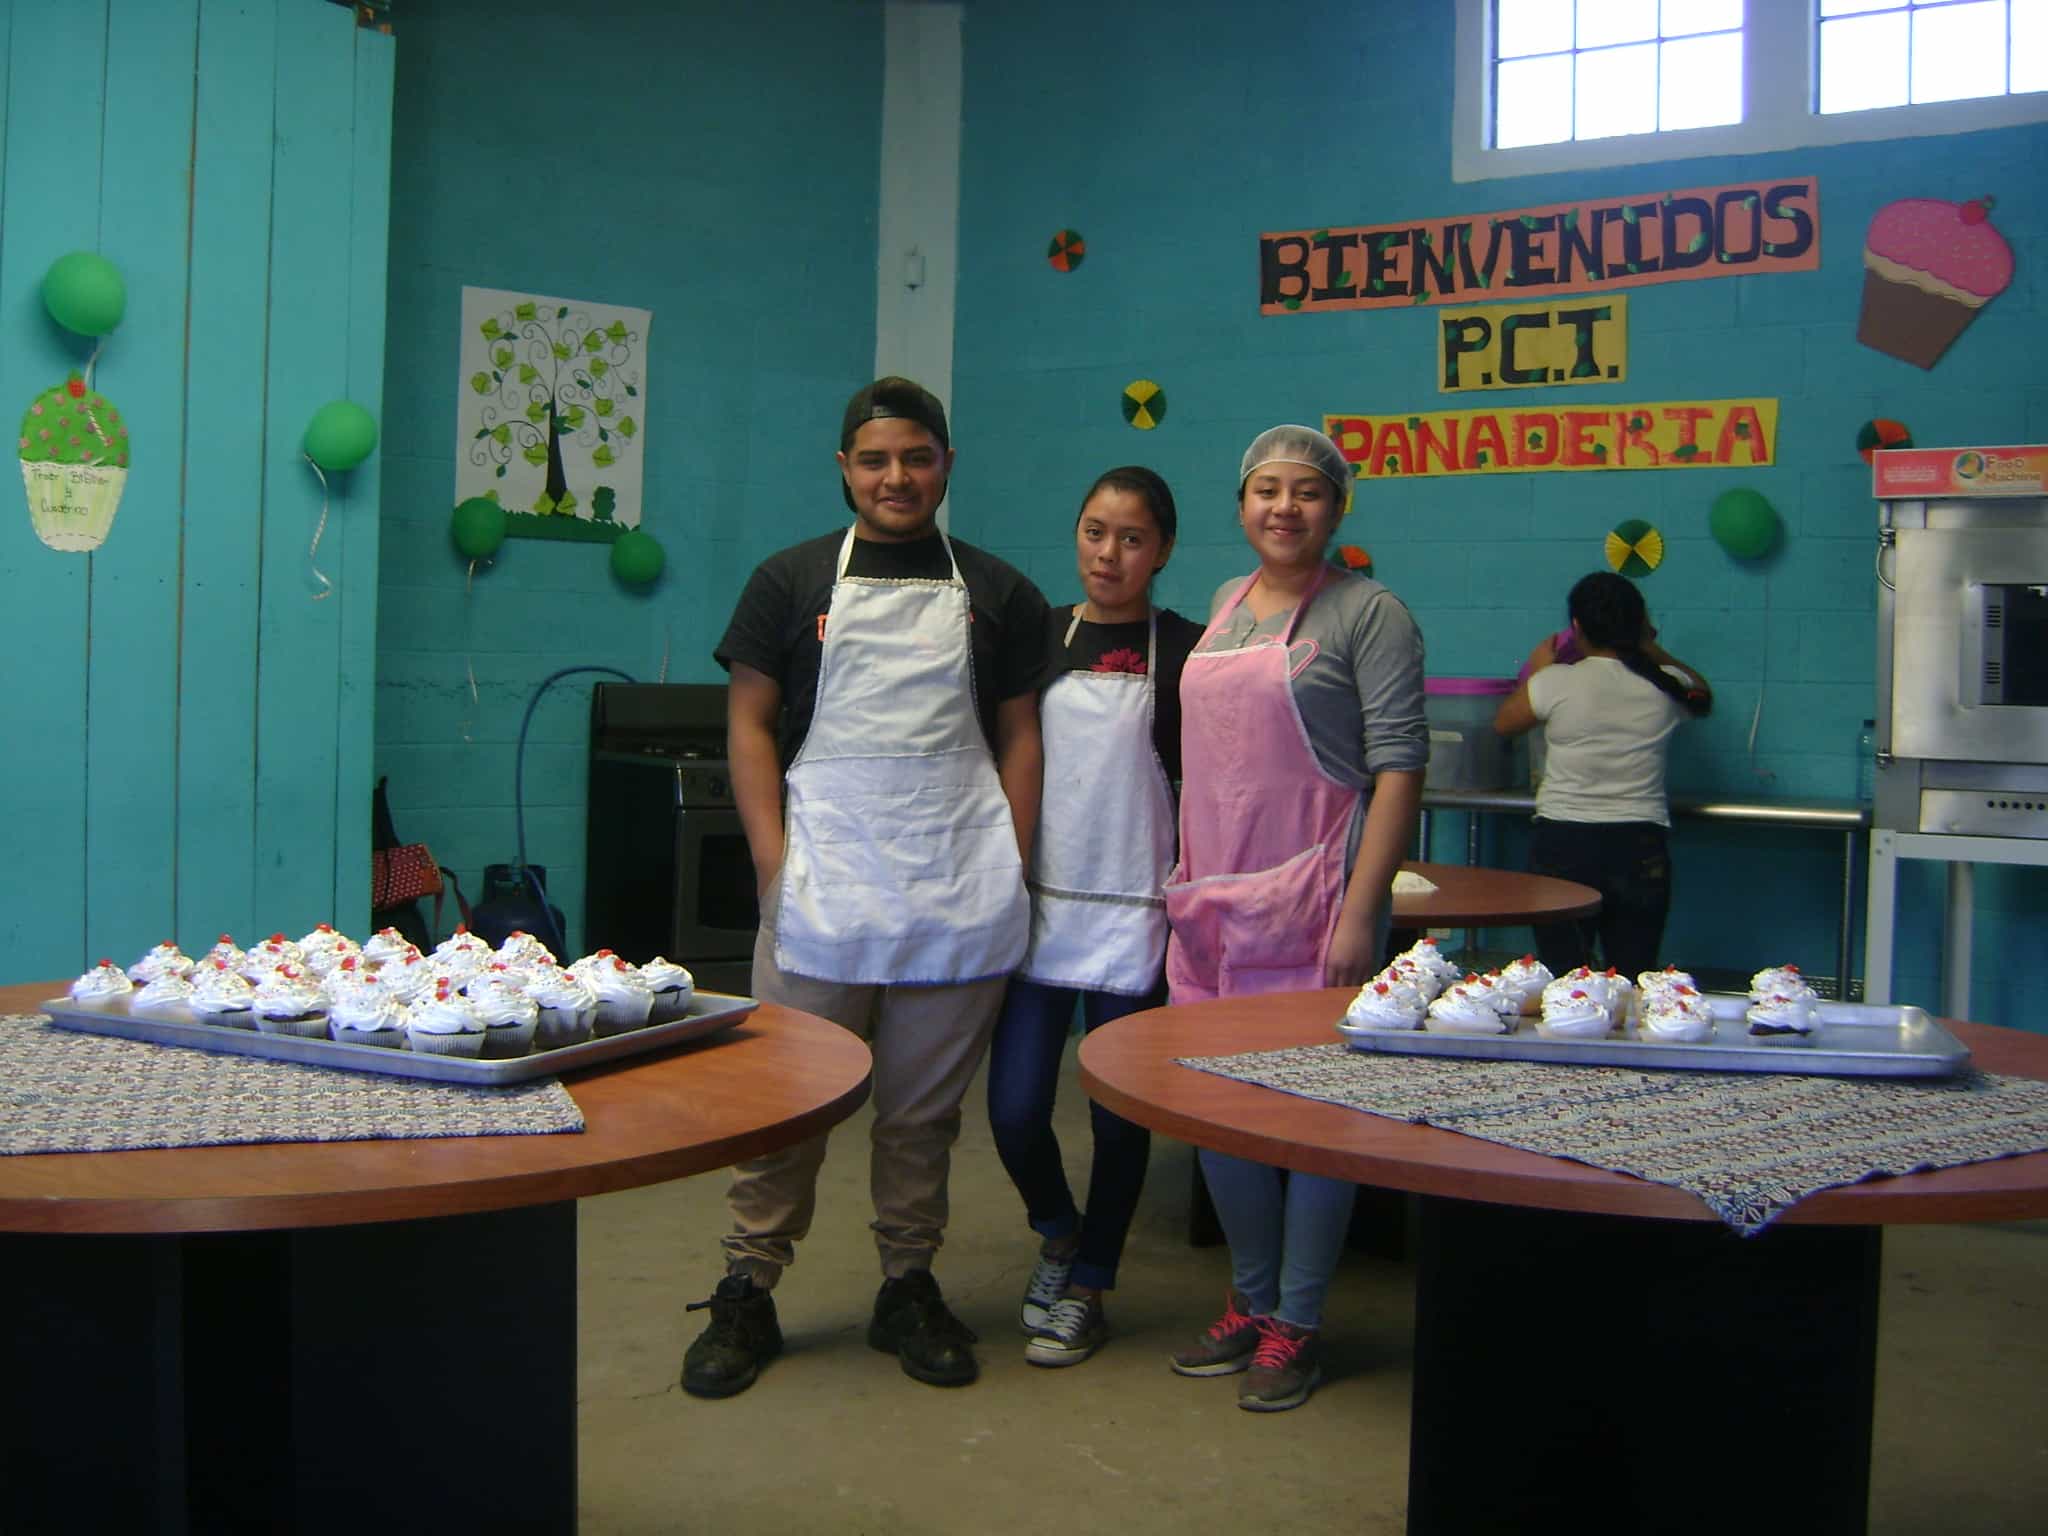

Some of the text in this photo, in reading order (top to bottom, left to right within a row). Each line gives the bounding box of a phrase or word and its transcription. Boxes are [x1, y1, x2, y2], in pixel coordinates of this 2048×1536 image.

[1260, 184, 1814, 305] BIENVENIDOS
[1442, 305, 1619, 388] P.C.T.
[1327, 406, 1769, 475] PANADERIA
